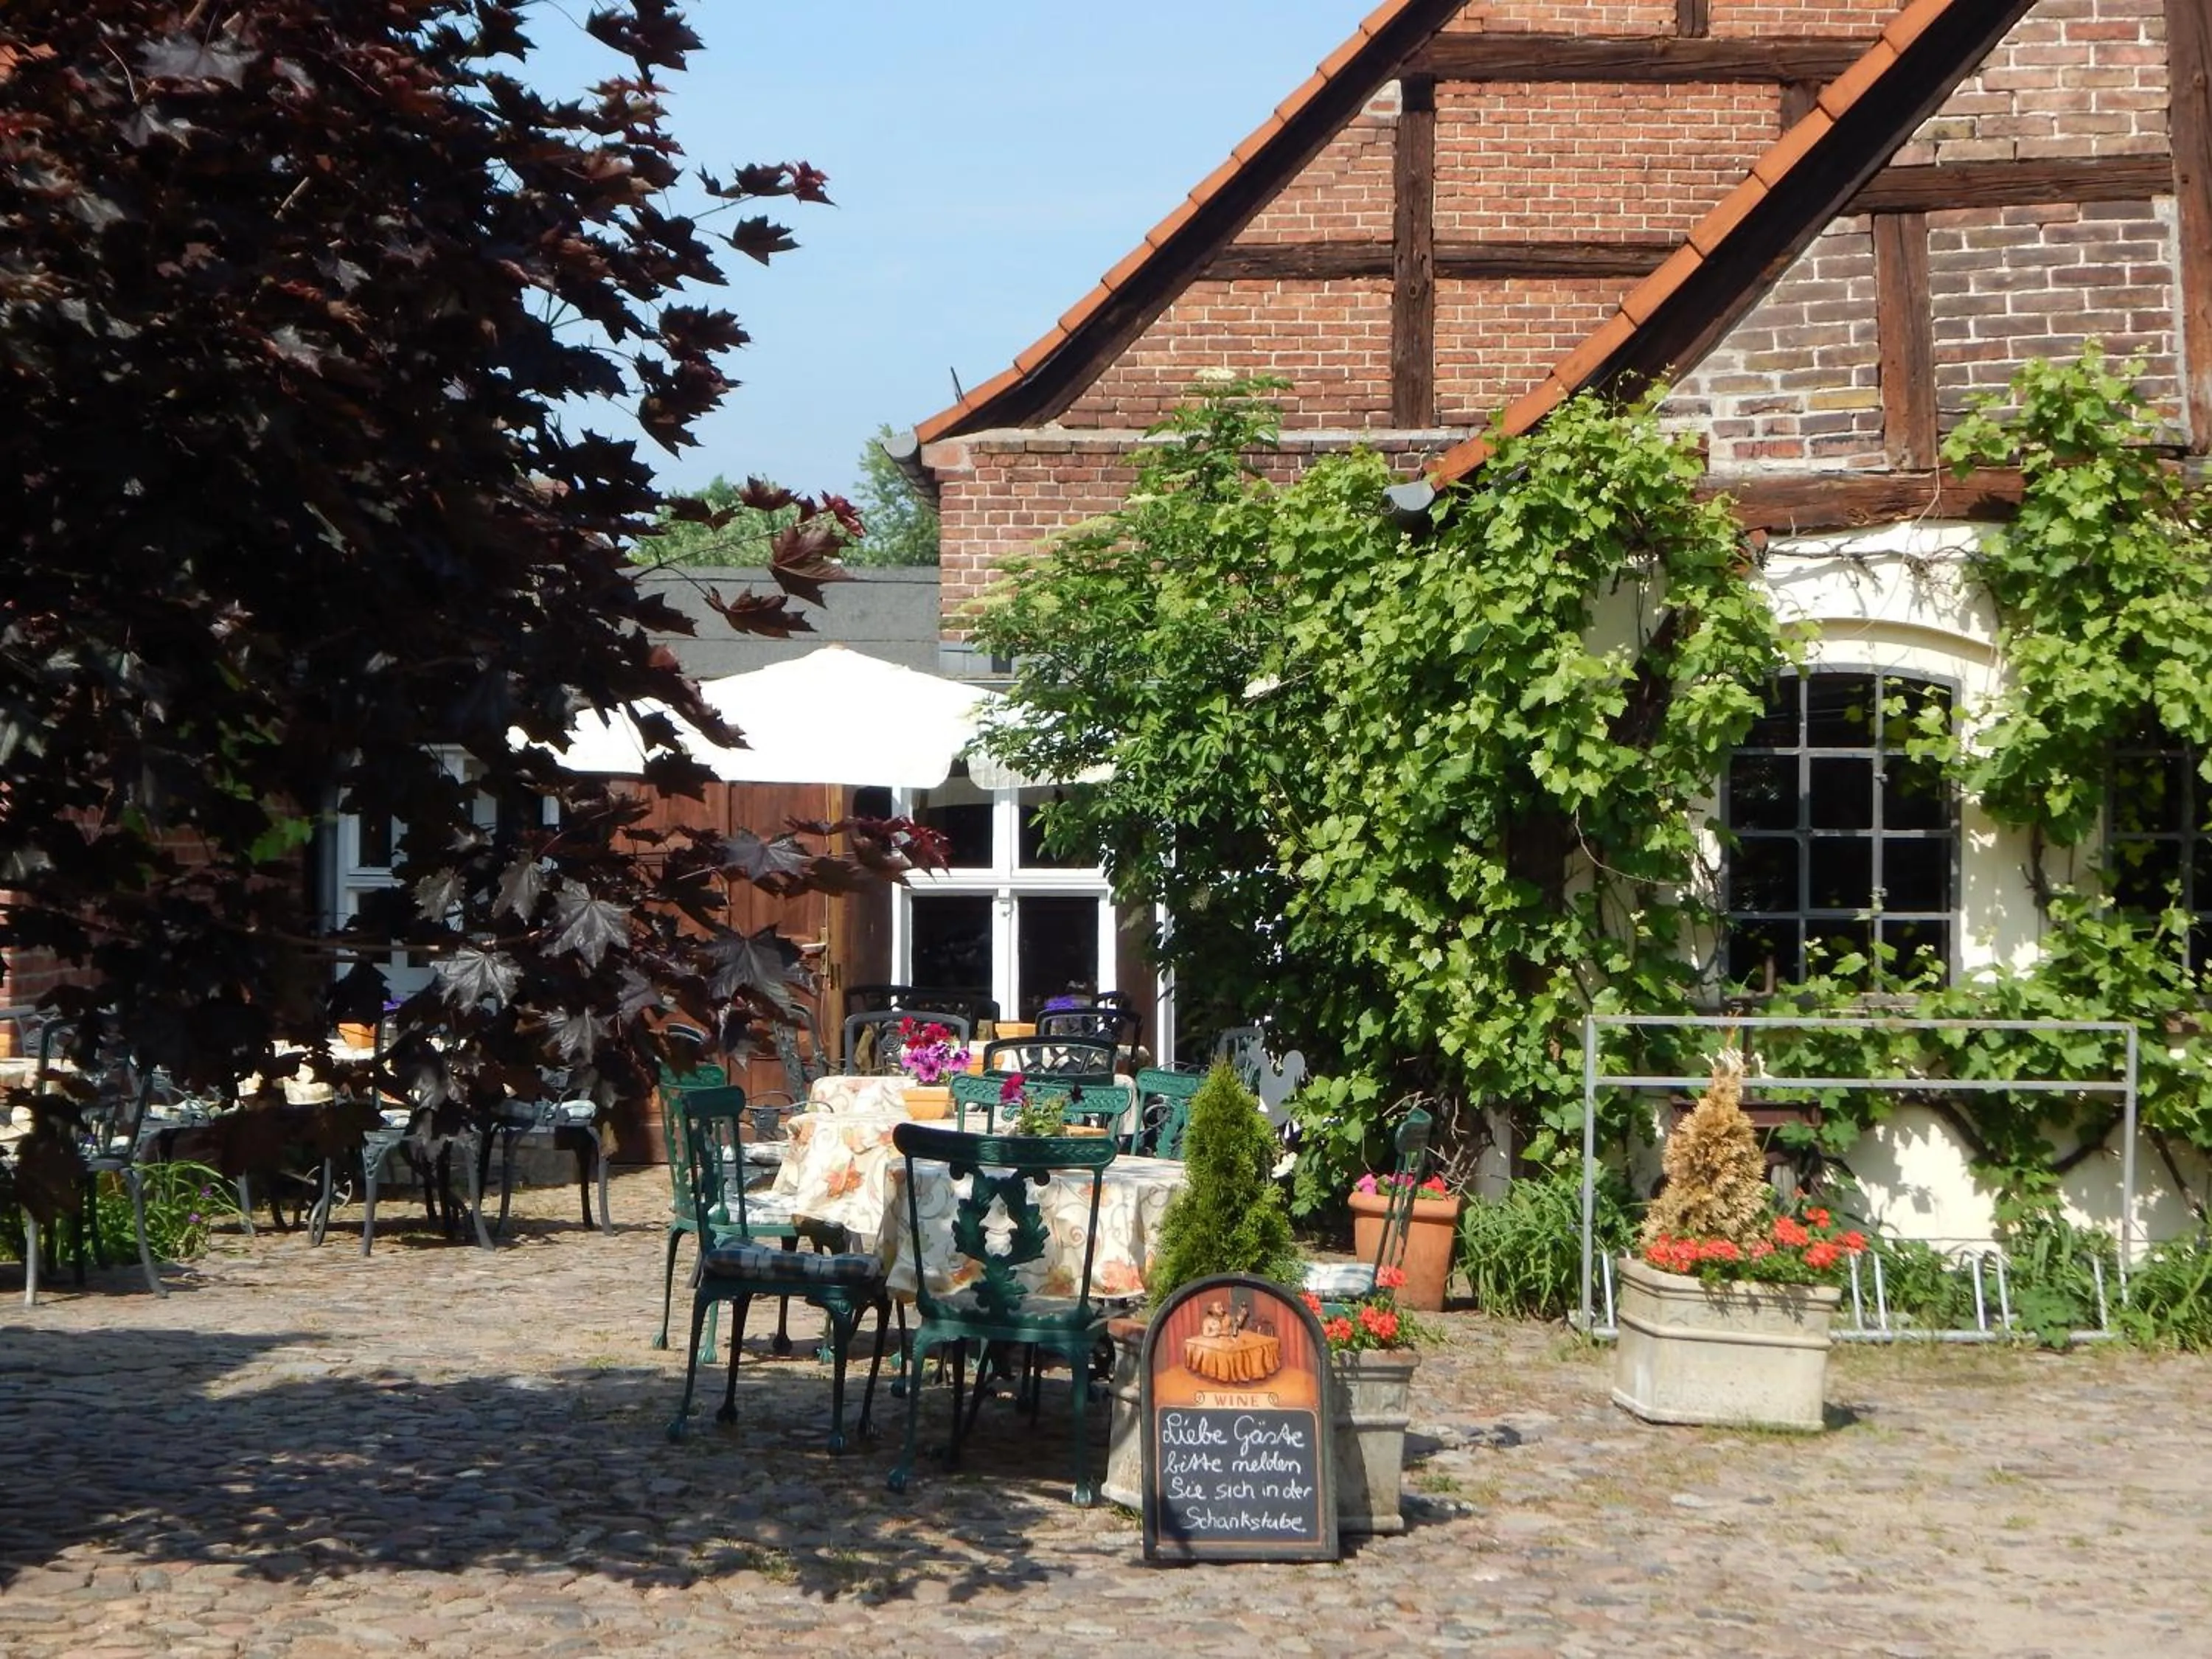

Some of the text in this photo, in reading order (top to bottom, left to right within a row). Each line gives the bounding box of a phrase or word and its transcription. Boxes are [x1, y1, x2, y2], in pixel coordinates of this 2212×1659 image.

[1214, 1395, 1260, 1407] WINE
[1163, 1413, 1305, 1457] Liebe Gäste
[1164, 1450, 1301, 1475] bitte melden
[1167, 1476, 1313, 1500] Sie sich in der
[1180, 1506, 1307, 1533] Schankstube
